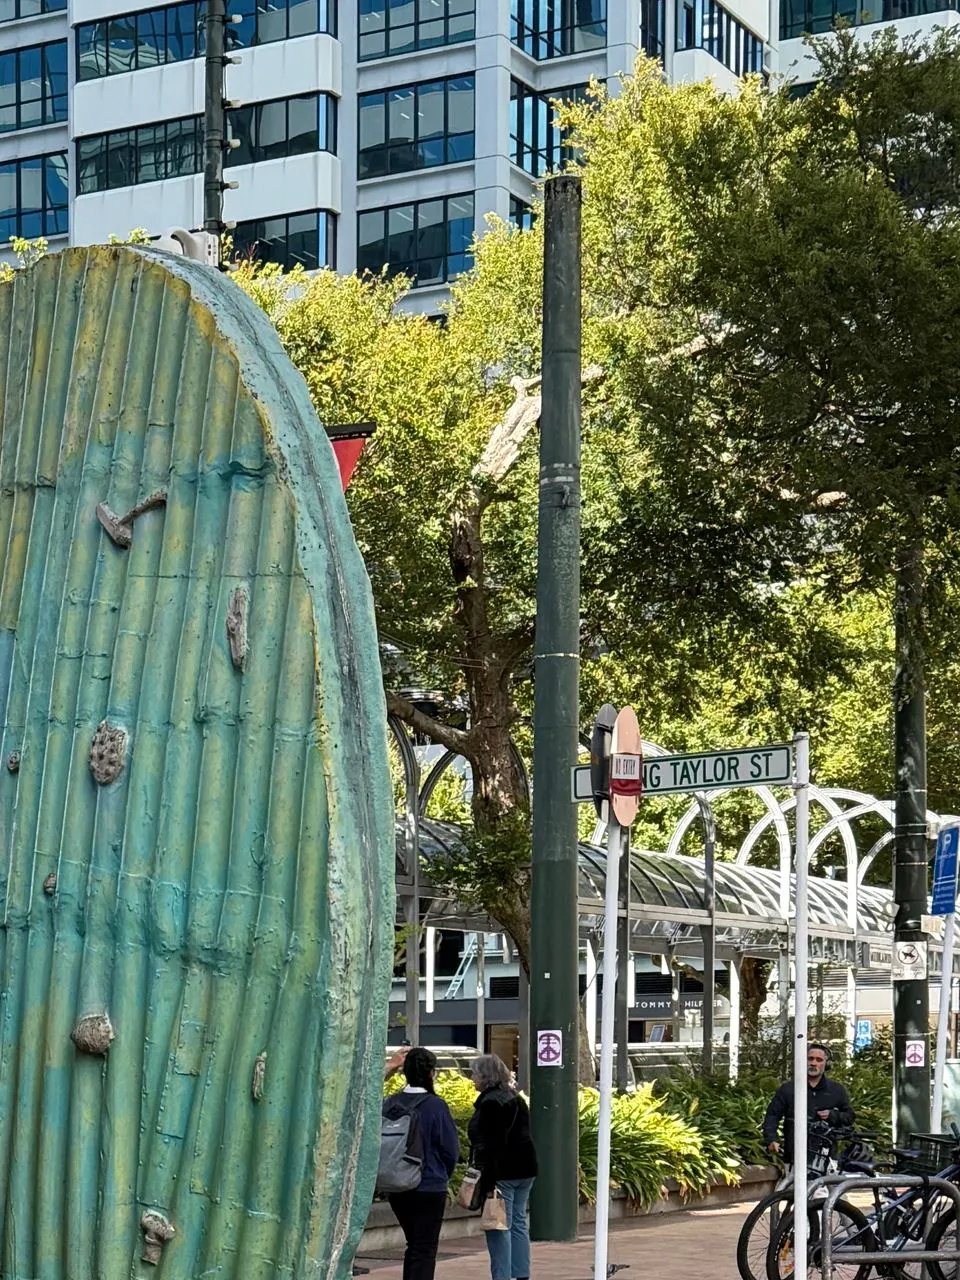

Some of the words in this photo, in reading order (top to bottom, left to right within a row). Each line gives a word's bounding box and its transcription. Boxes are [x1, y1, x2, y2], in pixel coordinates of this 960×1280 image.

[670, 756, 740, 785] TAYLOR
[750, 752, 773, 779] ST
[635, 1001, 672, 1009] TOMMY
[684, 1000, 723, 1008] HILFER
